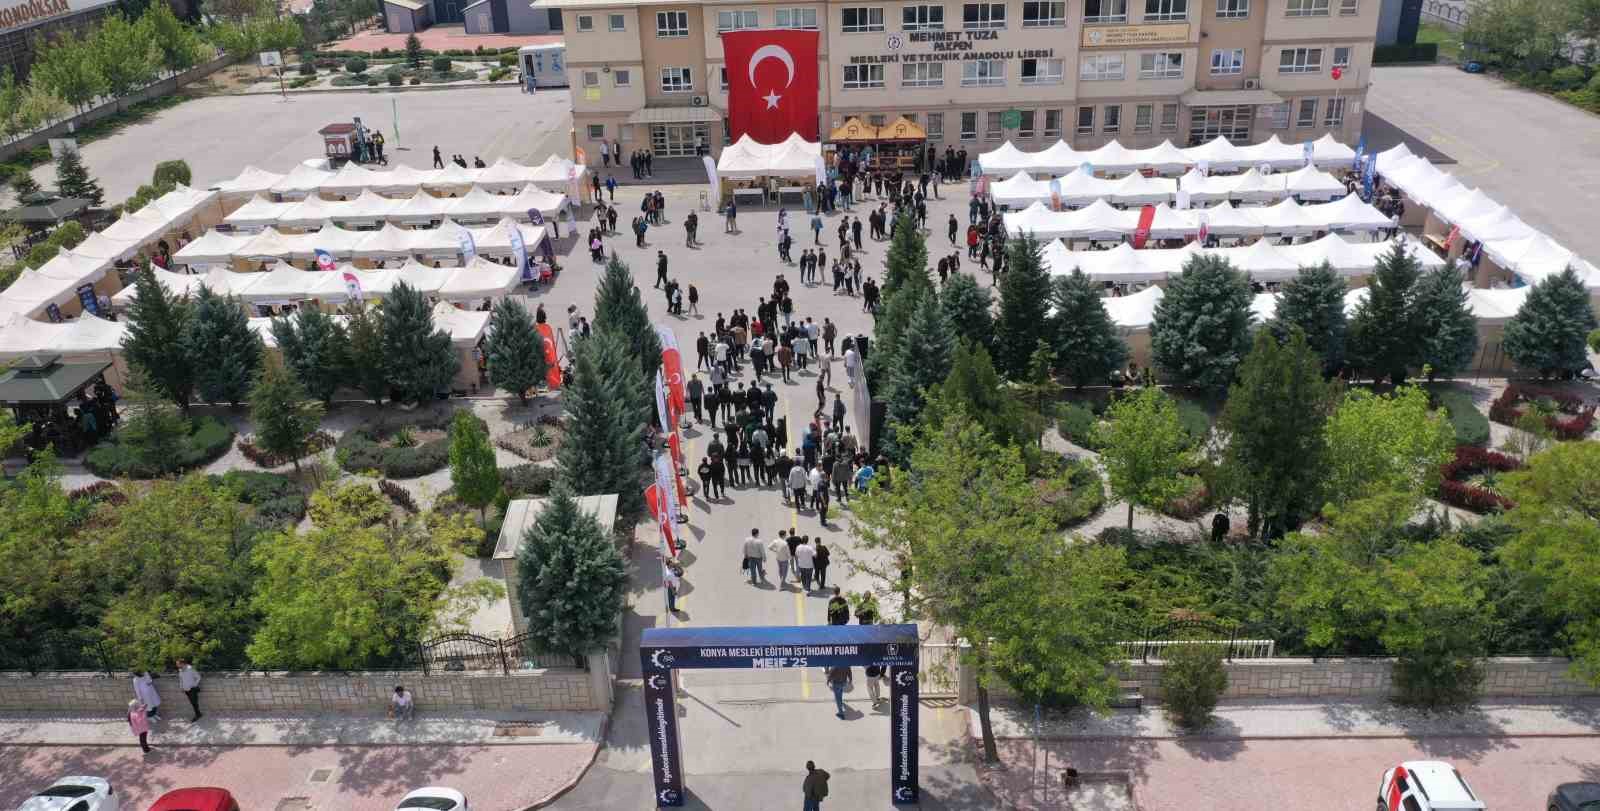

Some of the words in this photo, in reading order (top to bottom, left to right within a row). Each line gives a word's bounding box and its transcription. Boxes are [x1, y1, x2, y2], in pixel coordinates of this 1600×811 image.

[909, 31, 963, 42] MEHMET
[965, 30, 999, 41] TUZA
[933, 40, 974, 51] PAKPEN
[850, 54, 900, 64] MESLEKİ
[902, 53, 916, 62] VE
[917, 51, 961, 62] TEKNİK
[962, 50, 1014, 61] ANADOLU
[700, 648, 727, 657] KONYA
[728, 647, 763, 657] MESLEKİ
[764, 645, 793, 657] EĞİTİM
[794, 644, 833, 656] İSTİHDAM
[834, 645, 859, 656] FUARI
[790, 657, 808, 667] '25
